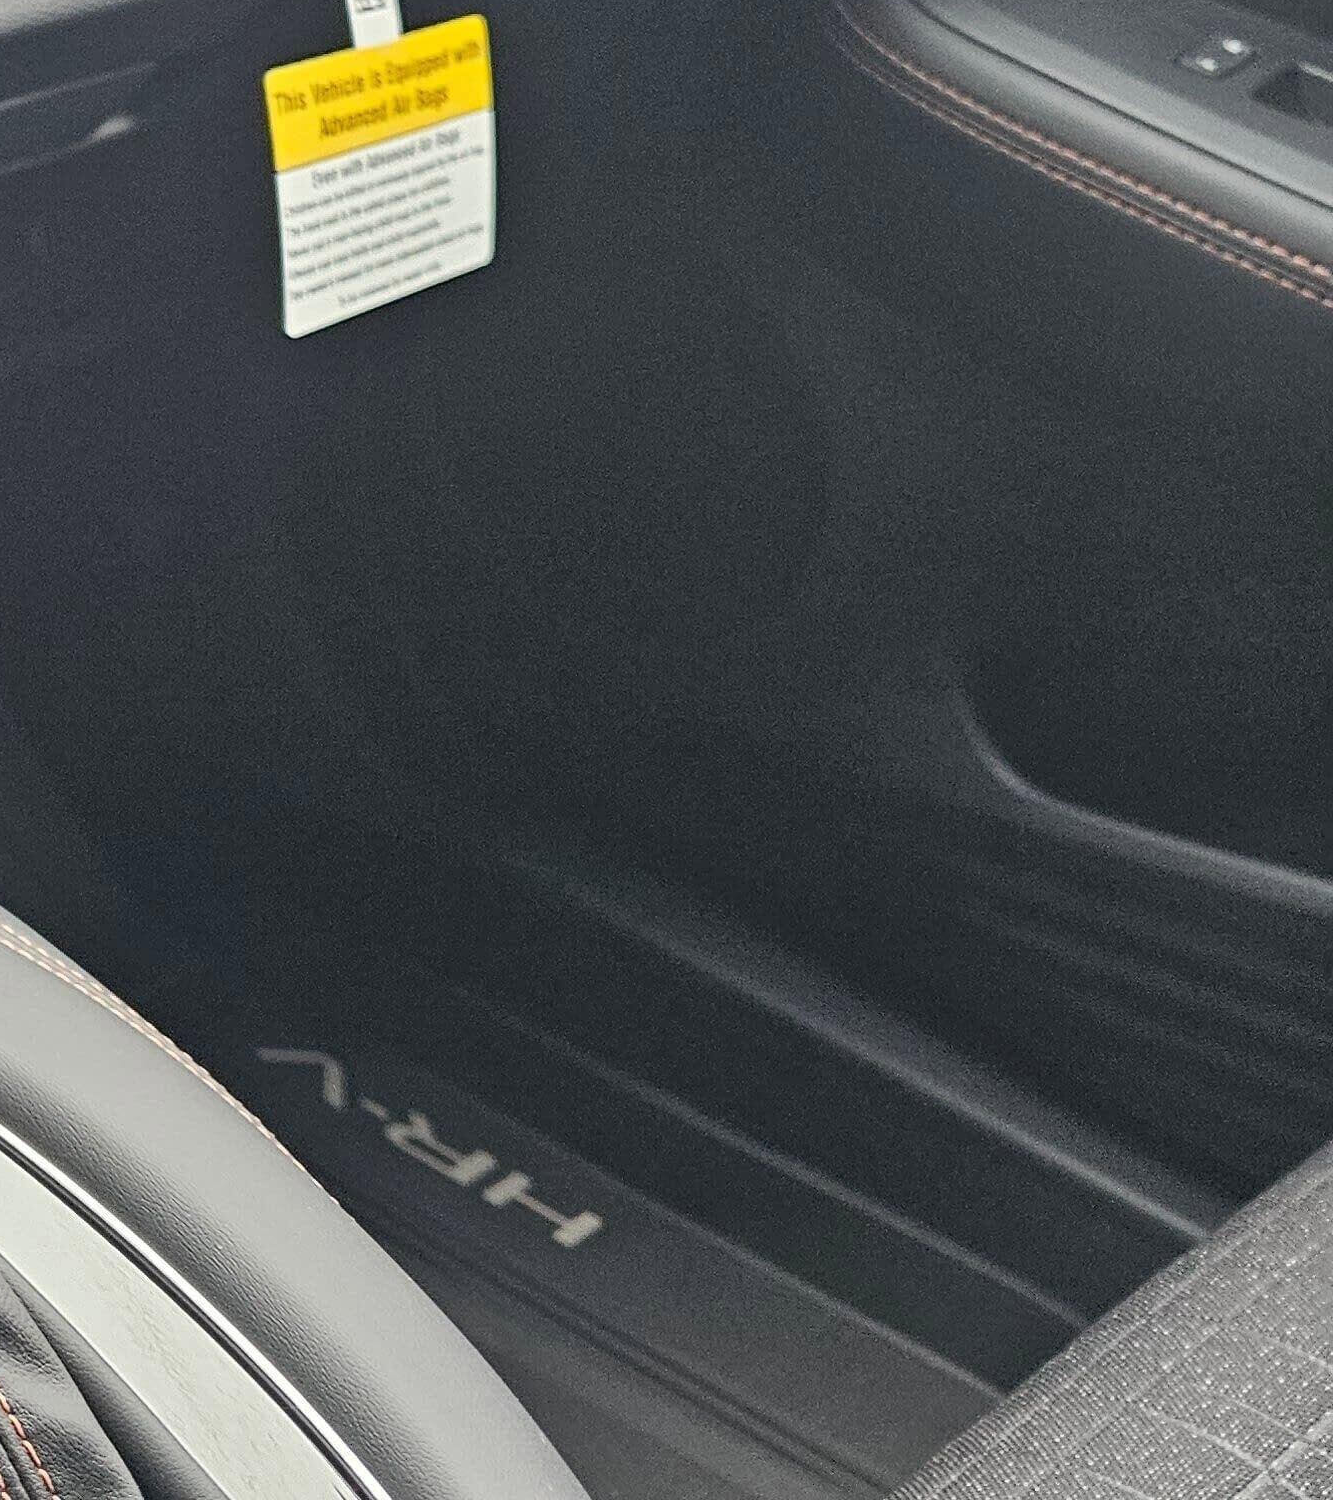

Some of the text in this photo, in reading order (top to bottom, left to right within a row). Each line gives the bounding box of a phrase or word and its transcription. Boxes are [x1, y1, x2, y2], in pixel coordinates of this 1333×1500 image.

[274, 91, 308, 116] This
[310, 74, 365, 107] Vehicle
[369, 68, 383, 89] is
[453, 40, 482, 65] with
[319, 104, 388, 141] Advanced
[255, 1046, 604, 1249] HR-V
